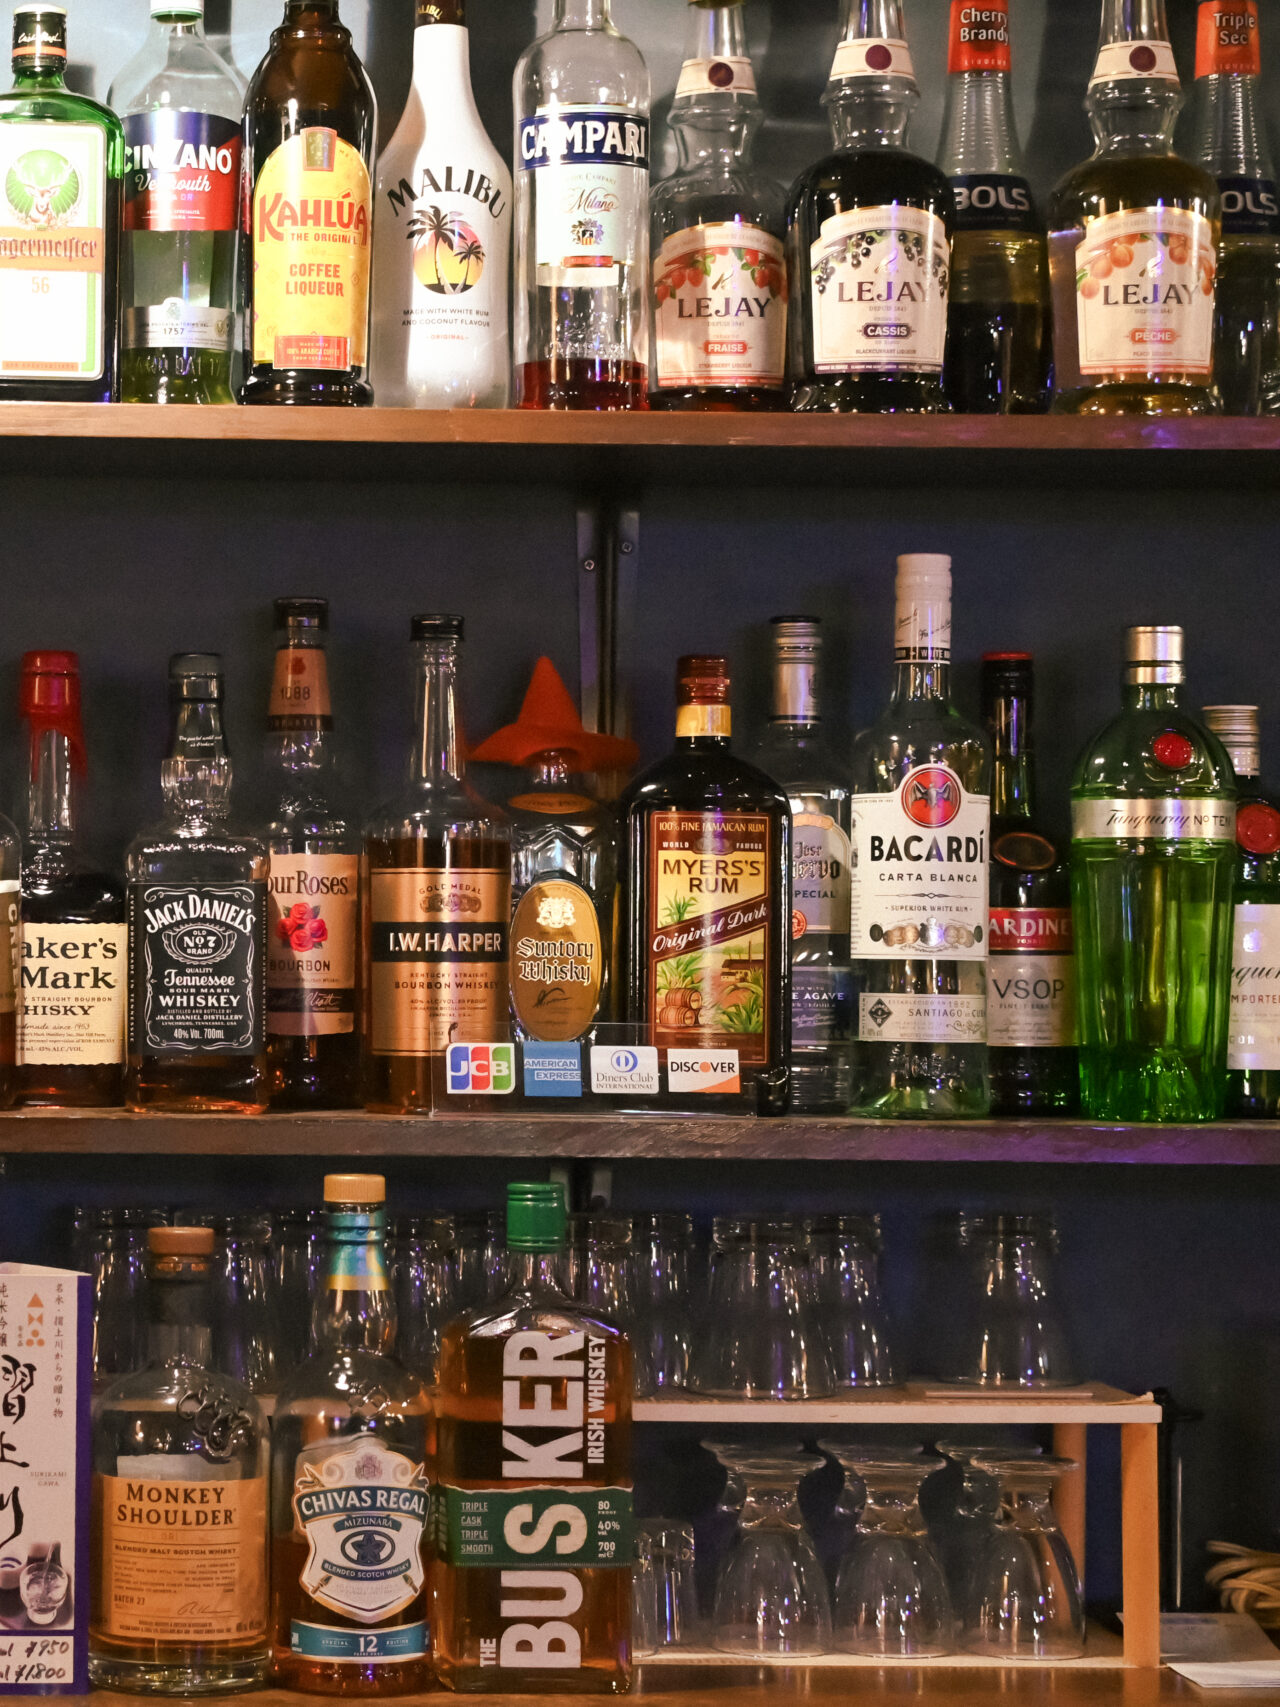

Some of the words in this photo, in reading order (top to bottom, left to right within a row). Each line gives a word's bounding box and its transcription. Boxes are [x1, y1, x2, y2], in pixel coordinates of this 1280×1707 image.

[961, 9, 1008, 27] Cherry
[1213, 13, 1255, 29] Triple
[961, 28, 1009, 44] Brandy
[1220, 31, 1248, 45] Sec
[521, 120, 646, 161] CAMPARI
[387, 166, 506, 219] MALIBU
[259, 193, 368, 243] KAHLÚA
[291, 232, 309, 241] THE
[289, 264, 340, 278] COFFEE
[31, 277, 50, 294] 56
[285, 281, 344, 297] LIQUEUR
[1103, 283, 1199, 305] LEJAY
[677, 297, 771, 319] LEJAY
[867, 326, 908, 336] CASSIS
[708, 343, 744, 353] FRAISE
[1105, 809, 1191, 829] Tanqueray
[680, 822, 700, 831] FINE
[702, 822, 746, 832] JAMAICAN
[748, 823, 766, 833] RUM
[870, 829, 986, 864] BACARDÍ
[663, 859, 762, 876] MYERS'S
[295, 870, 348, 896] Roses
[689, 877, 739, 894] RUM
[879, 873, 923, 882] CARTA
[930, 873, 979, 883] BLANCA
[144, 899, 187, 934] JACK
[188, 894, 257, 934] DANIEL'S
[652, 917, 726, 952] Original
[727, 903, 767, 930] Dark
[206, 936, 217, 948] 7
[424, 932, 502, 952] HARPER
[517, 937, 593, 961] Suntory
[269, 960, 331, 971] BOURBON
[518, 960, 593, 986] Whisky
[21, 966, 116, 990] Mark
[164, 969, 236, 987] Tennessee
[394, 981, 451, 989] BOURBON
[455, 981, 498, 990] WHISKEY
[804, 992, 846, 1001] AGAVE
[992, 979, 1065, 1000] VSOP
[158, 995, 241, 1007] WHISKEY
[908, 1008, 963, 1017] SANTIAGO
[524, 1059, 577, 1069] AMERICAN
[535, 1071, 581, 1081] EXPRESS
[596, 1071, 628, 1084] Diners
[629, 1071, 654, 1084] Club
[587, 1335, 606, 1413] WHISKEY
[587, 1417, 605, 1464] IRISH
[126, 1483, 226, 1504] MONKEY
[479, 1637, 496, 1668] THE
[500, 1330, 588, 1669] BUSKER
[301, 1490, 371, 1516] CHIVAS
[376, 1489, 425, 1515] REGAL
[461, 1502, 488, 1512] TRIPLE
[598, 1501, 610, 1510] 80
[117, 1505, 234, 1526] SHOULDER
[344, 1516, 393, 1528] MIZUNARA
[461, 1516, 482, 1525] CASK
[598, 1521, 620, 1531] 40%
[461, 1530, 488, 1539] TRIPLE
[150, 1546, 170, 1554] MALT
[461, 1544, 493, 1553] SMOOTH
[598, 1541, 616, 1551] 700
[324, 1562, 355, 1577] BLENDED
[357, 1570, 385, 1578] SCOTCH
[358, 1636, 378, 1653] 12
